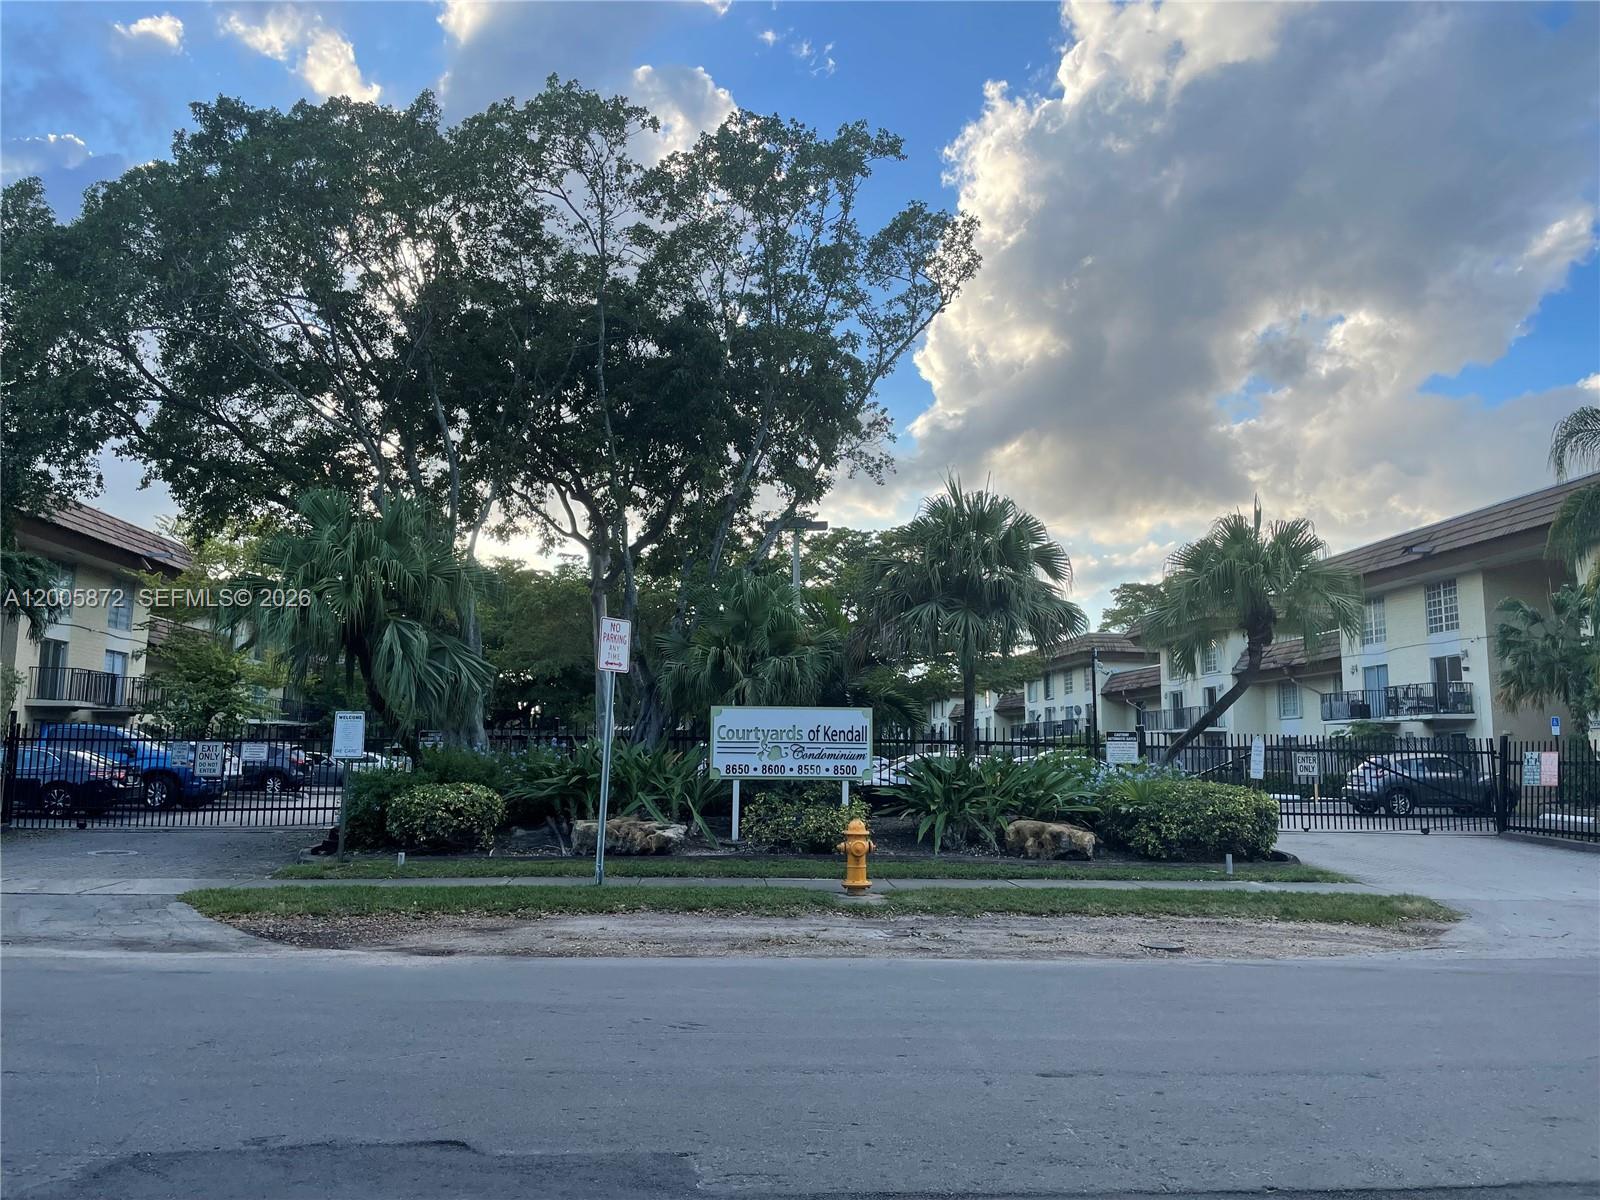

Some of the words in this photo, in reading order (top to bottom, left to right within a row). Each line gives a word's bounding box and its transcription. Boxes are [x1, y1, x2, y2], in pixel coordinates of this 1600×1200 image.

[610, 622, 621, 632] NO
[603, 632, 627, 645] PARKING
[608, 644, 619, 652] ANY
[717, 725, 803, 743] Courtyards
[808, 725, 821, 741] of
[823, 725, 868, 742] Kendall
[199, 753, 220, 761] ONLY
[790, 744, 867, 760] Condominium
[1297, 755, 1317, 764] ENTER
[725, 764, 749, 774] 8650
[761, 764, 785, 775] 8600
[797, 764, 821, 775] 8550
[833, 765, 857, 775] 8500
[1299, 764, 1315, 773] ONLY
